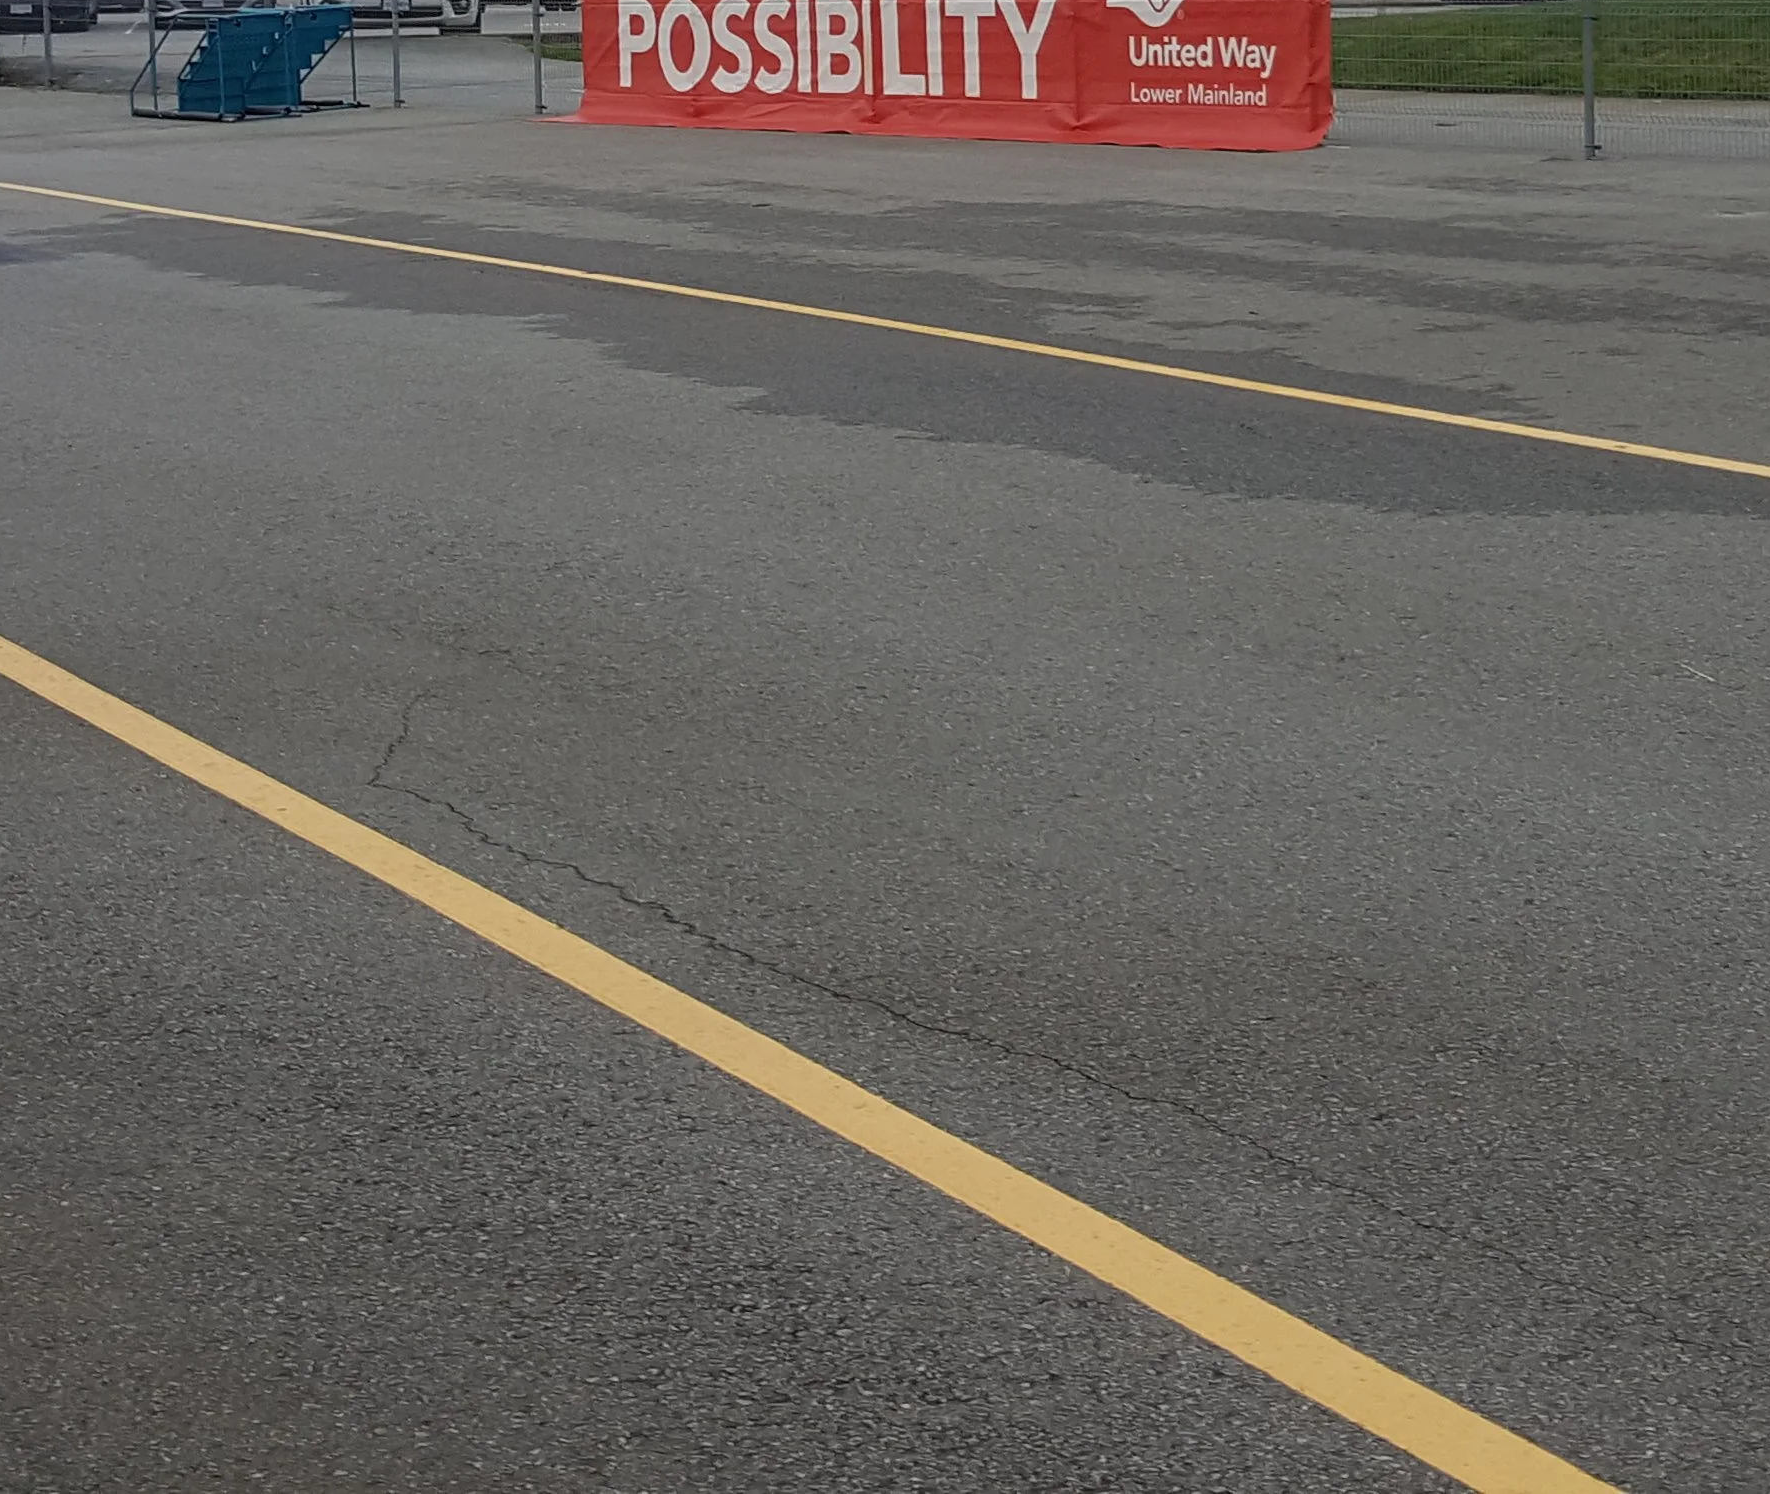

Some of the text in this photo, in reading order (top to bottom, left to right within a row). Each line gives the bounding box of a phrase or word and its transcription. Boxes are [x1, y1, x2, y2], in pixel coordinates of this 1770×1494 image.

[1129, 35, 1277, 79] United Way
[1130, 81, 1267, 106] Lower Mainland
